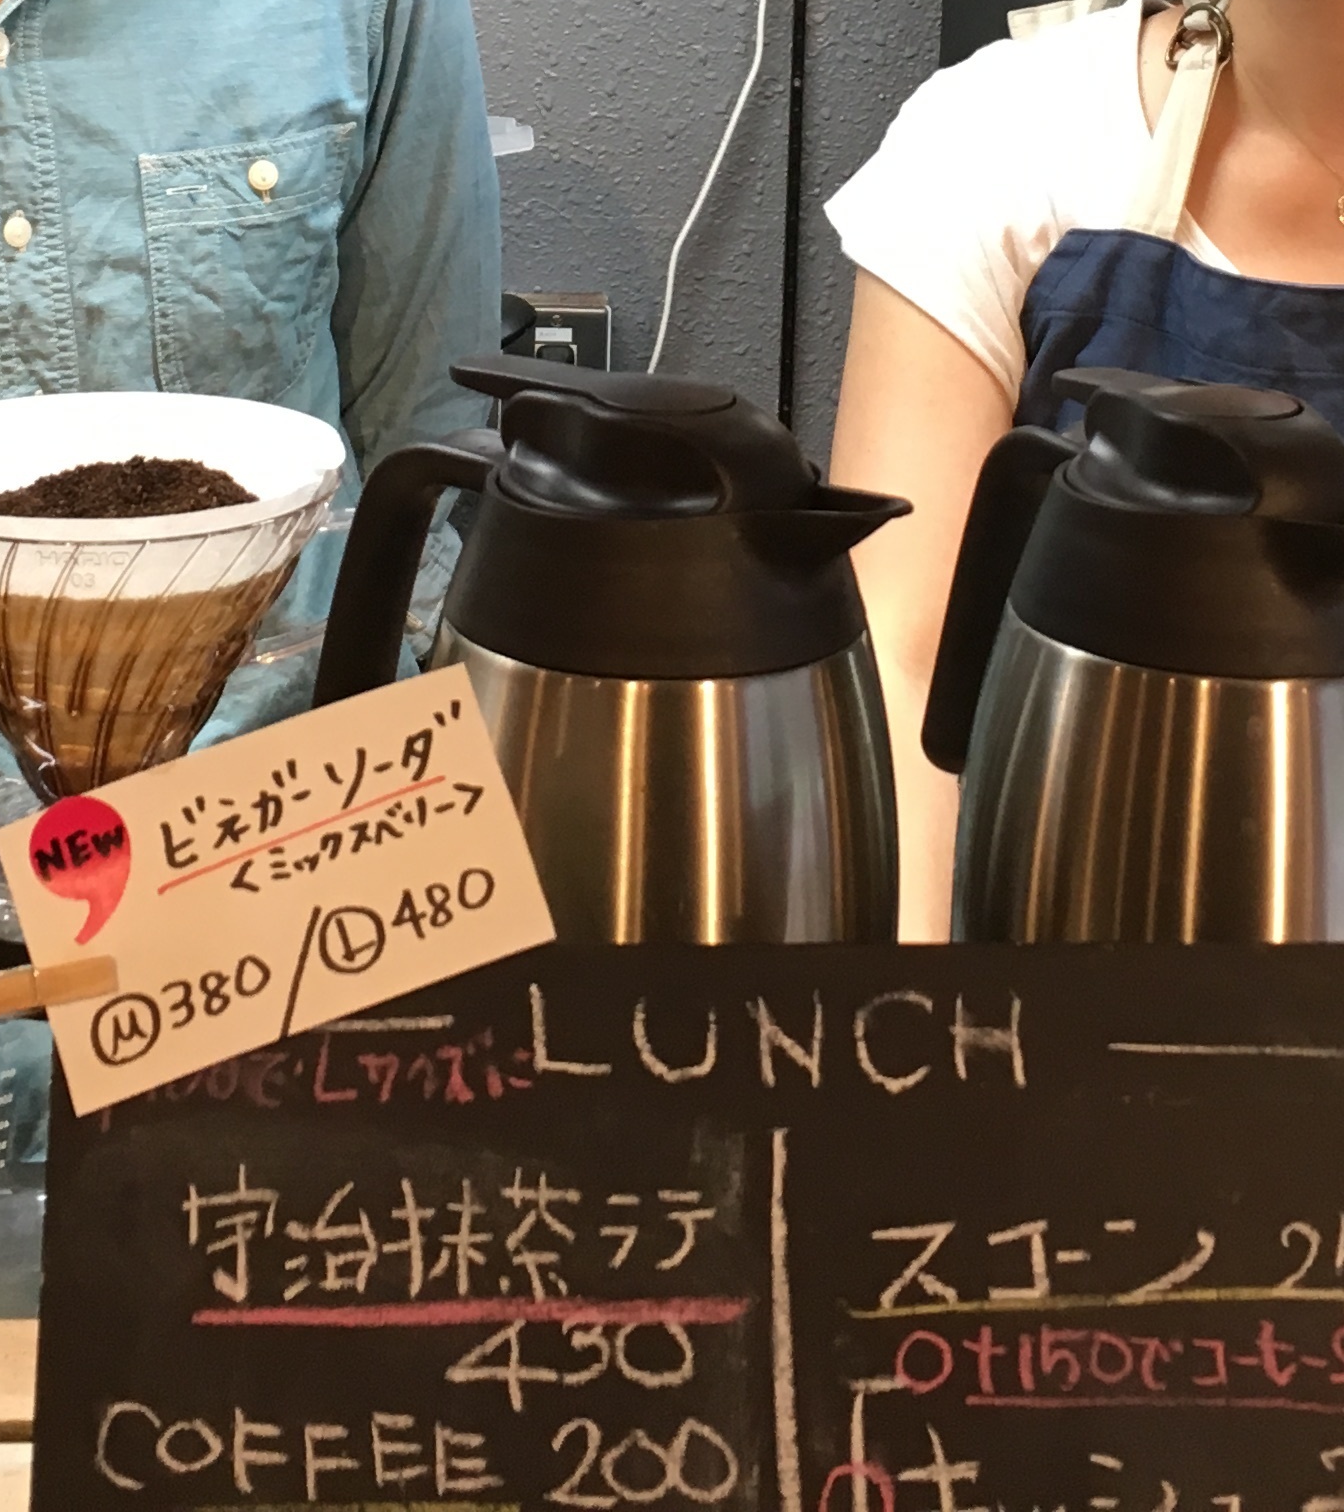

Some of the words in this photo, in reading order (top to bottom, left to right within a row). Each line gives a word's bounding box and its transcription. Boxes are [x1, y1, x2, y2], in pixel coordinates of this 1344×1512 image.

[34, 825, 126, 879] NEW
[530, 981, 1027, 1093] LUNCH
[181, 1163, 716, 1304] 宇治抹茶ラテ
[871, 1219, 1216, 1308] スコーン
[444, 1316, 696, 1413] 430
[96, 1399, 504, 1501] COFFEE
[543, 1417, 740, 1507] 200
